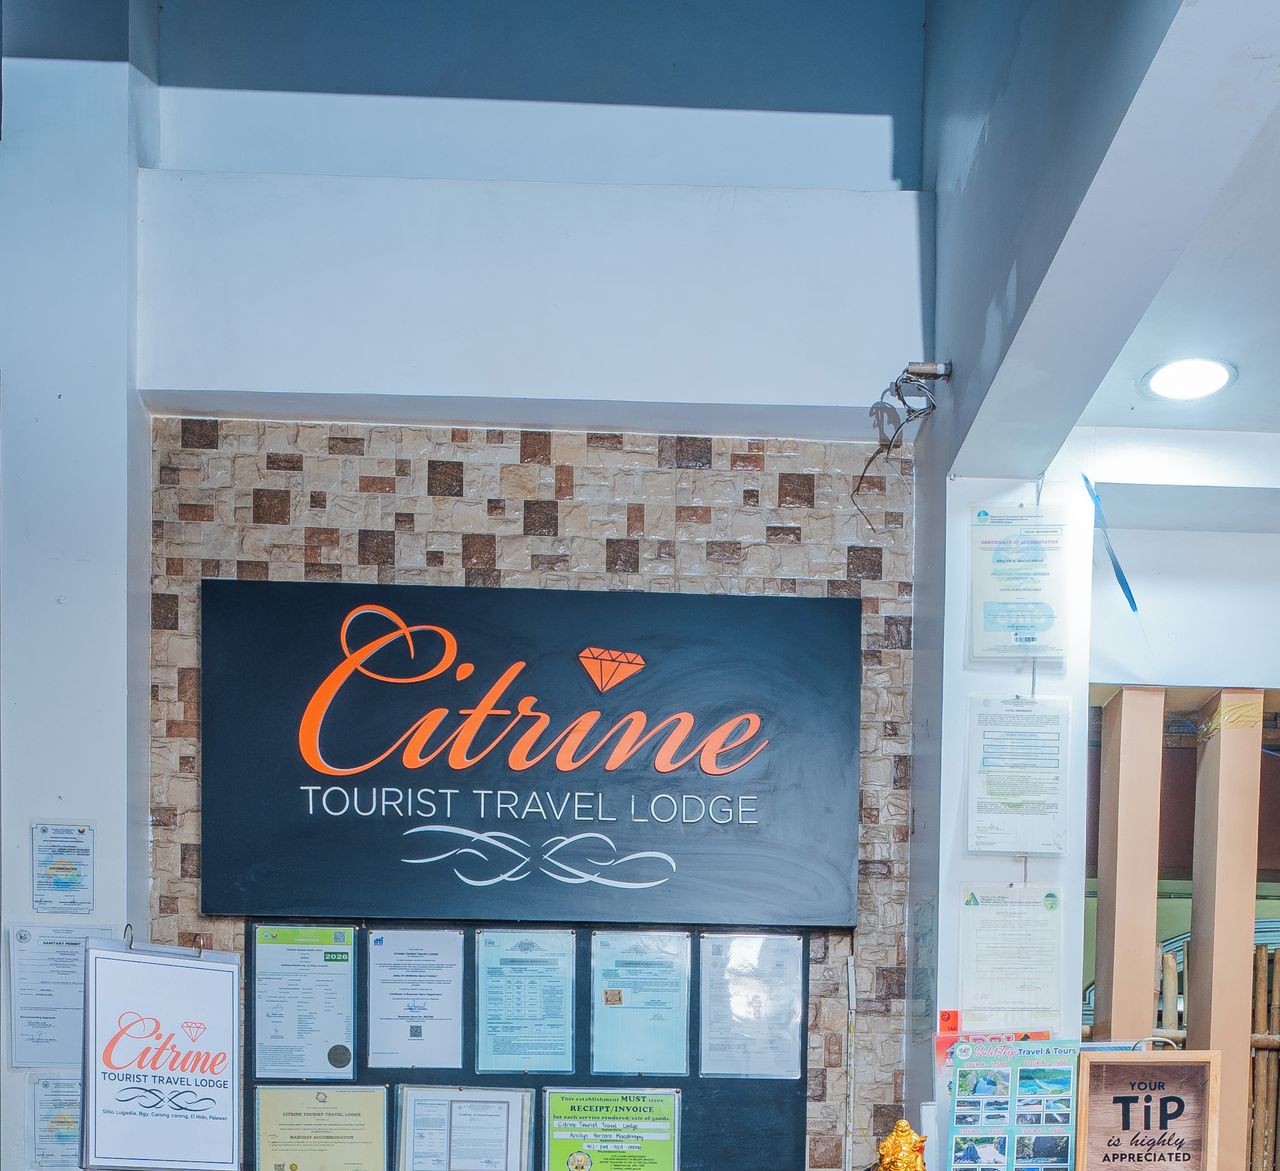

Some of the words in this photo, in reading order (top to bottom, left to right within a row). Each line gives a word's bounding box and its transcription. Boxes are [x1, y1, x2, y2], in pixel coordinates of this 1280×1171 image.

[299, 604, 768, 777] Citrine
[300, 786, 460, 819] TOURIST
[473, 790, 616, 822] TRAVEL
[631, 795, 758, 825] LODGE
[102, 1011, 228, 1076] Citrine
[1018, 1047, 1043, 1056] Travel
[1053, 1047, 1076, 1055] Tours
[101, 1071, 148, 1084] TOURIST
[152, 1075, 192, 1087] TRAVEL
[195, 1078, 228, 1088] LODGE
[1129, 1081, 1165, 1091] YOUR
[570, 1105, 655, 1113] RECEIPT/INVOICE
[1113, 1094, 1185, 1131] TiP
[1107, 1135, 1121, 1147] is
[1129, 1132, 1186, 1152] highly
[1102, 1152, 1191, 1162] APPRECIATED
